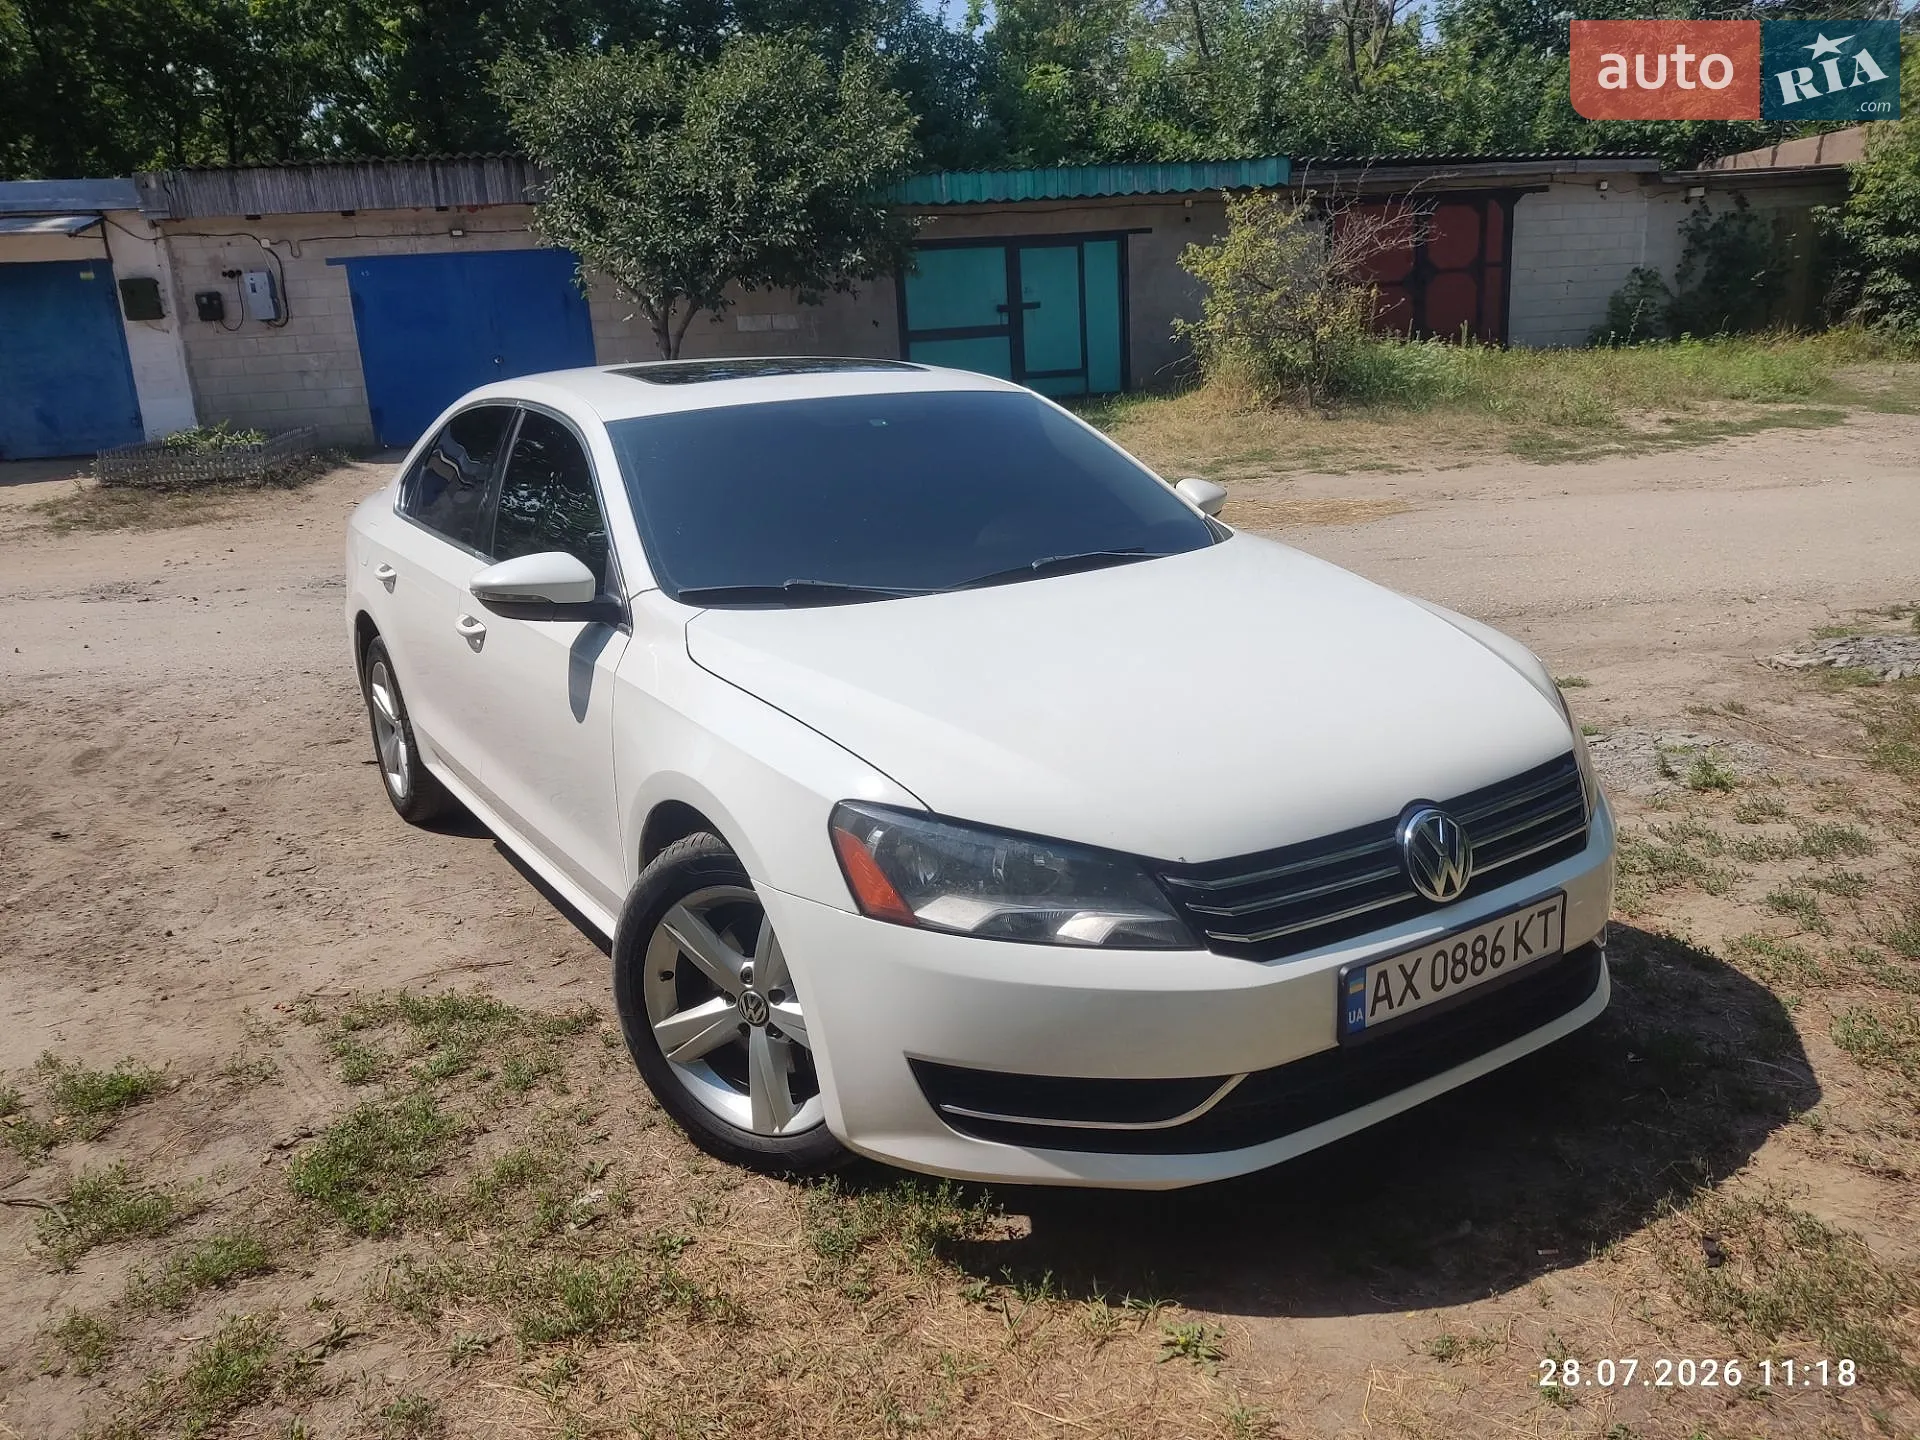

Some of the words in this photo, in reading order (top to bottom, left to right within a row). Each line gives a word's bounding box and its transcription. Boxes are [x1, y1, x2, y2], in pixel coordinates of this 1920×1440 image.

[1369, 957, 1422, 1017] AX
[1430, 926, 1506, 993] 0886
[1513, 905, 1558, 962] KT
[1348, 1008, 1365, 1024] UA
